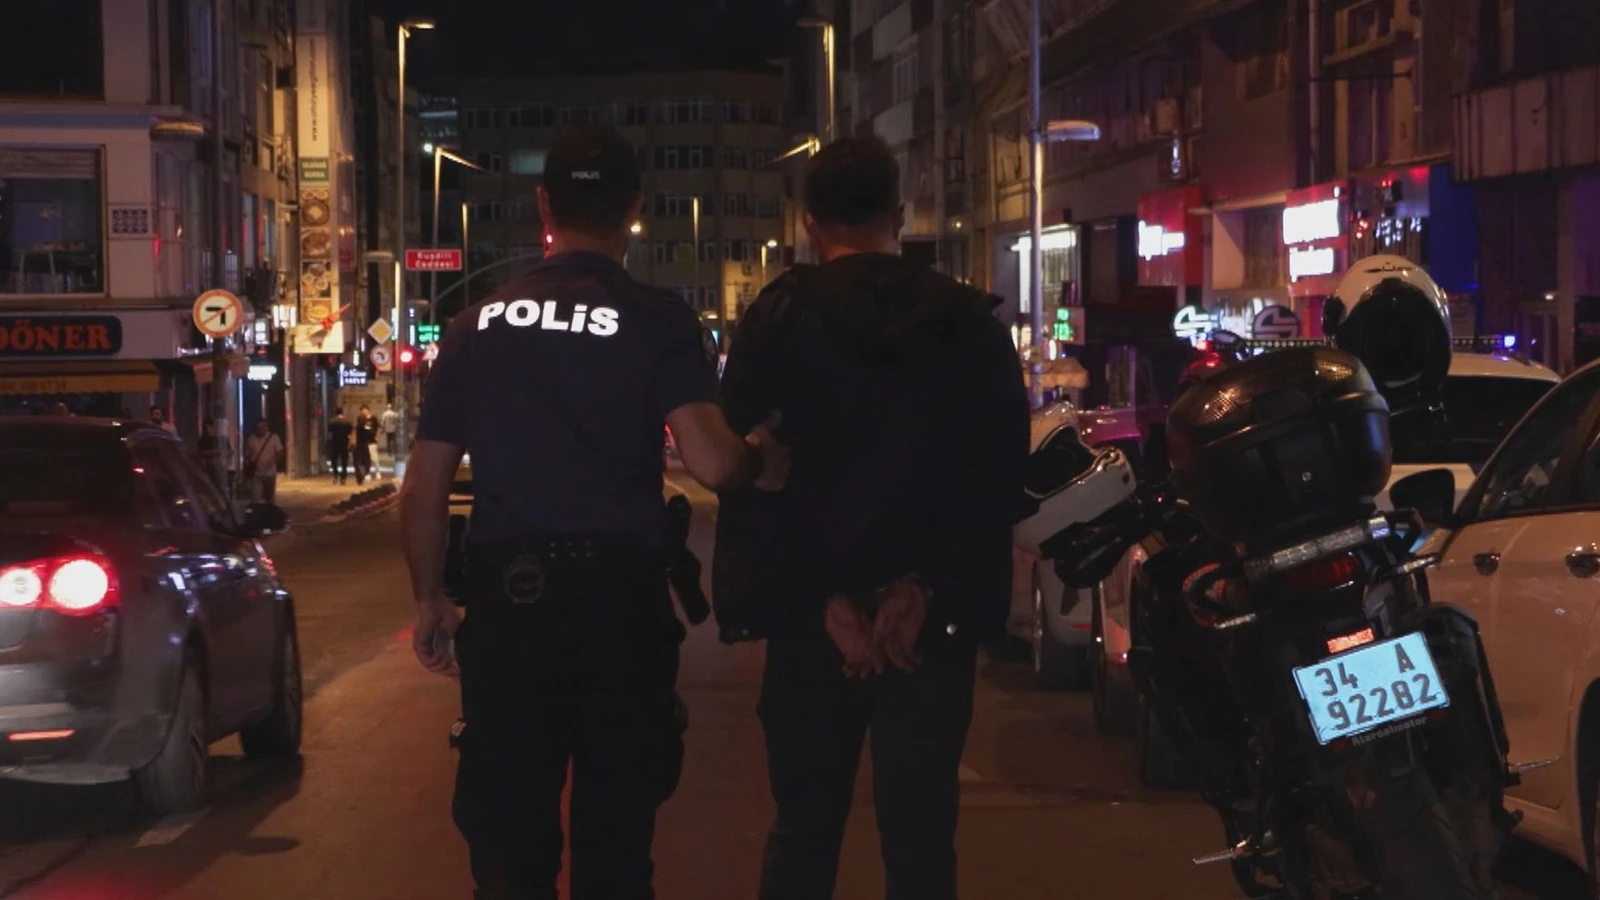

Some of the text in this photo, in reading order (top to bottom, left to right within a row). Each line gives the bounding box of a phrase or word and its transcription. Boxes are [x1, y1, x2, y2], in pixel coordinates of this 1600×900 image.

[1315, 642, 1415, 697] 34 A
[1327, 673, 1437, 730] 92282
